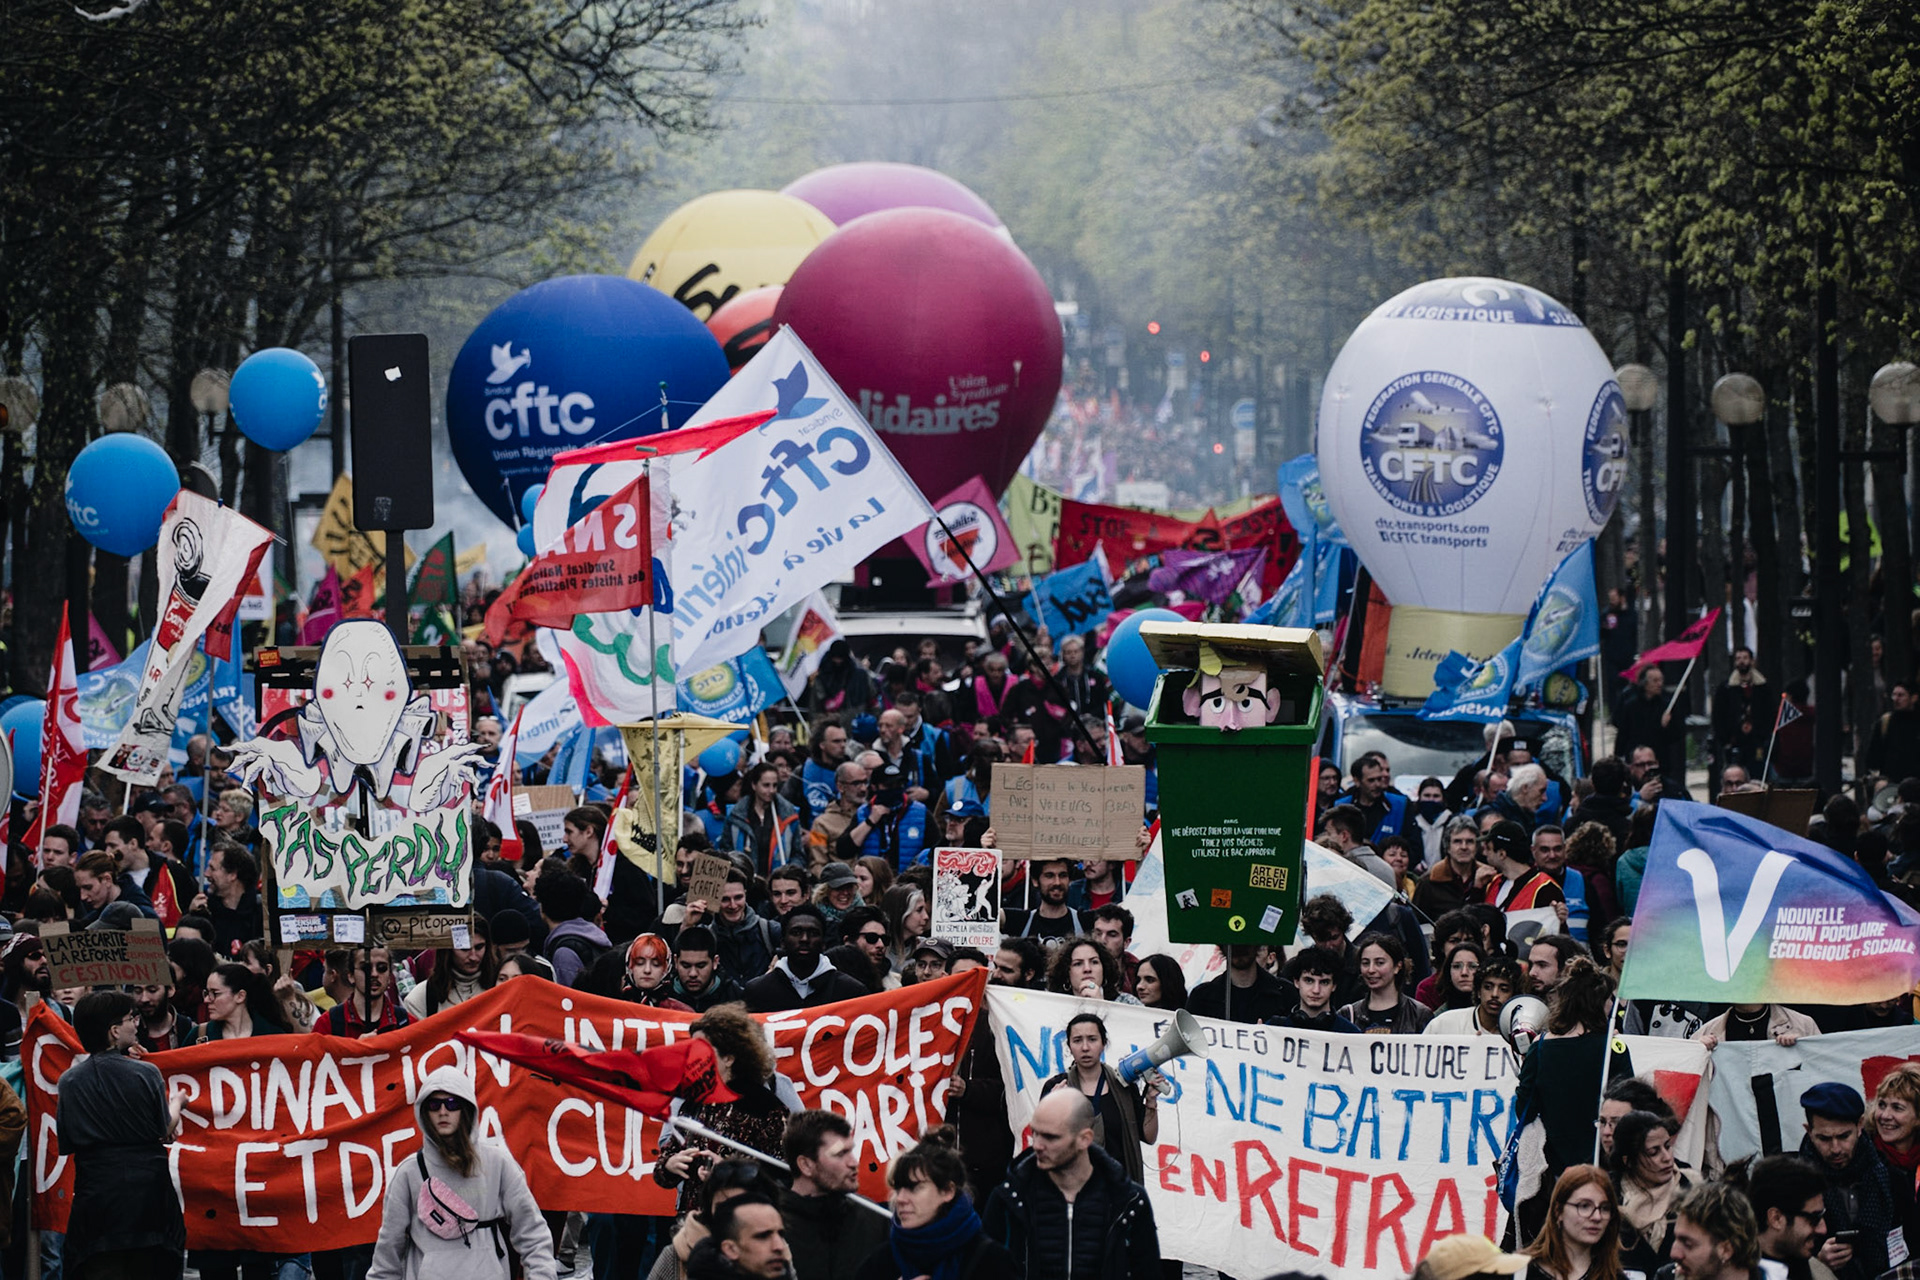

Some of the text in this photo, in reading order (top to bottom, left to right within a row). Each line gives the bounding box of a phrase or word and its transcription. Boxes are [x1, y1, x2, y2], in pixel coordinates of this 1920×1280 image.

[484, 381, 596, 441] cftc
[856, 388, 1001, 435] lidaires
[1364, 372, 1499, 436] FEDERATION GENERALE CFTC
[492, 450, 521, 462] Union
[1379, 450, 1478, 486] CFTC
[1363, 456, 1424, 516] TRANSPORTS
[1439, 463, 1499, 516] LOGISTIQUE
[1420, 534, 1488, 549] transports
[260, 801, 469, 904] T'AS PERDU
[1191, 848, 1220, 858] UTILISEZ
[1222, 849, 1230, 857] LE
[1230, 848, 1244, 857] BAC
[1201, 838, 1220, 847] TRIEZ
[1221, 838, 1235, 847] VOS
[1252, 866, 1287, 879] ART EN
[1776, 907, 1845, 925] NOUVELLE
[46, 937, 66, 952] LA
[1772, 922, 1888, 942] UNION POPULAIRE
[51, 954, 71, 966] LA
[1769, 941, 1851, 962] ÉCOLOGIQUE
[1862, 939, 1916, 956] SOCIALE
[59, 963, 107, 984] C'EST
[107, 962, 148, 981] NON
[764, 996, 974, 1087] ÉCOLES
[1282, 1036, 1307, 1068] DE
[1323, 1042, 1354, 1075] LA
[1370, 1042, 1470, 1080] CULTURE
[1204, 1057, 1286, 1134] NE
[235, 1138, 329, 1227] ET
[1157, 1144, 1227, 1203] EN
[1233, 1140, 1500, 1274] RETRAi
